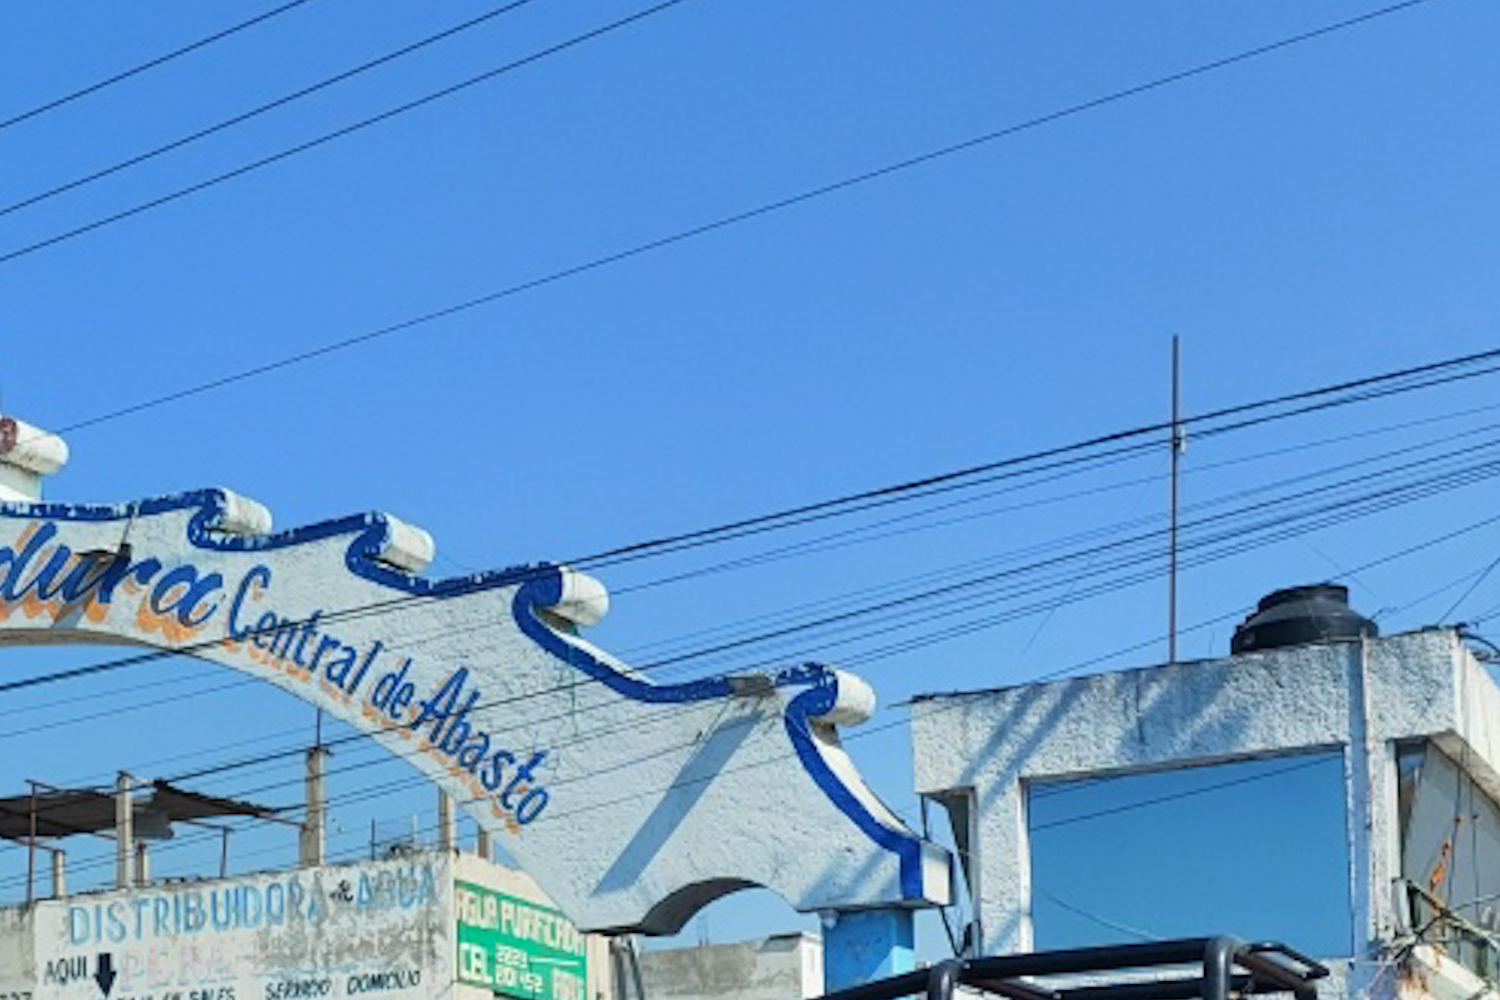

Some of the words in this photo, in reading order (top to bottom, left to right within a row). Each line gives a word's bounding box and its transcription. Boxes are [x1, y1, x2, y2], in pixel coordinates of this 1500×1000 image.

[230, 566, 380, 695] Central
[373, 658, 415, 721] de
[414, 666, 549, 826] Abasto
[68, 872, 327, 946] DISTRIBUIDORA
[356, 864, 437, 909] AGUA
[43, 957, 87, 985] AQUI
